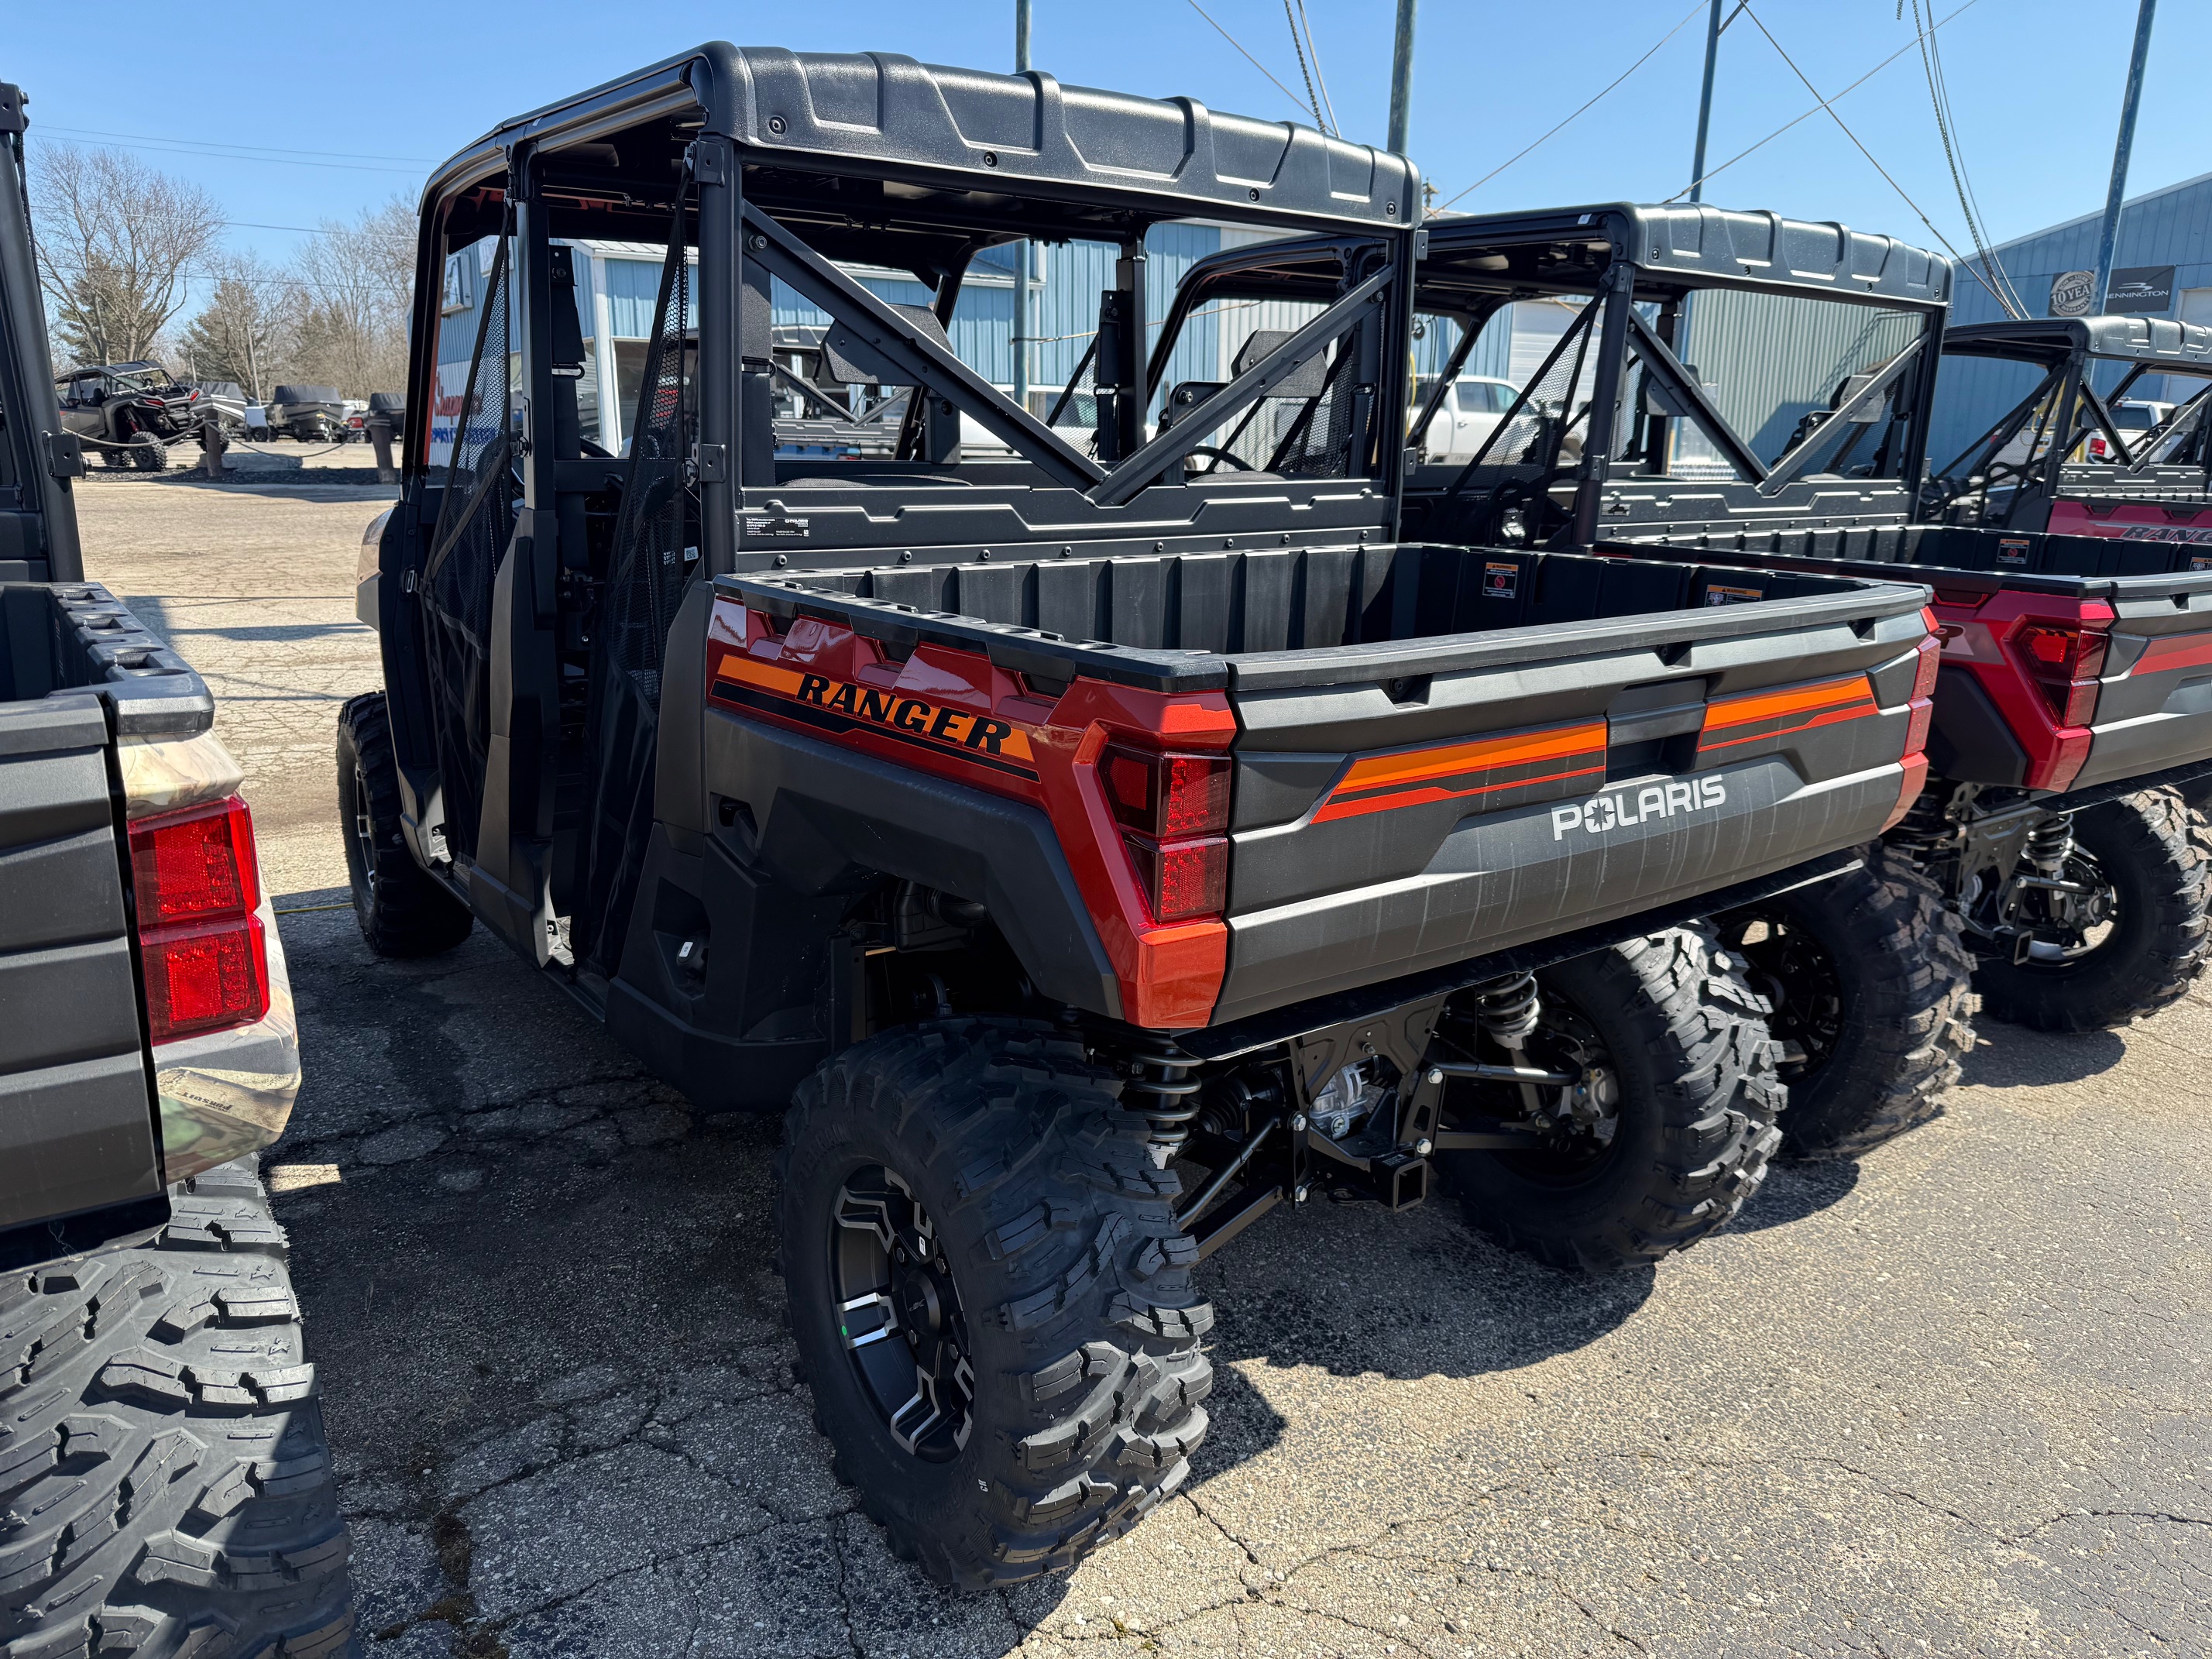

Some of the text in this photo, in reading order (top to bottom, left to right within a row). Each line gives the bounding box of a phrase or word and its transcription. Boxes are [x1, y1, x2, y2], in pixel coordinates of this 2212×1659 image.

[2051, 284, 2090, 305] 10 YEA
[2106, 290, 2169, 300] ENNINGTON
[795, 672, 1011, 756] RANGER
[1551, 774, 1726, 841] POLARIS
